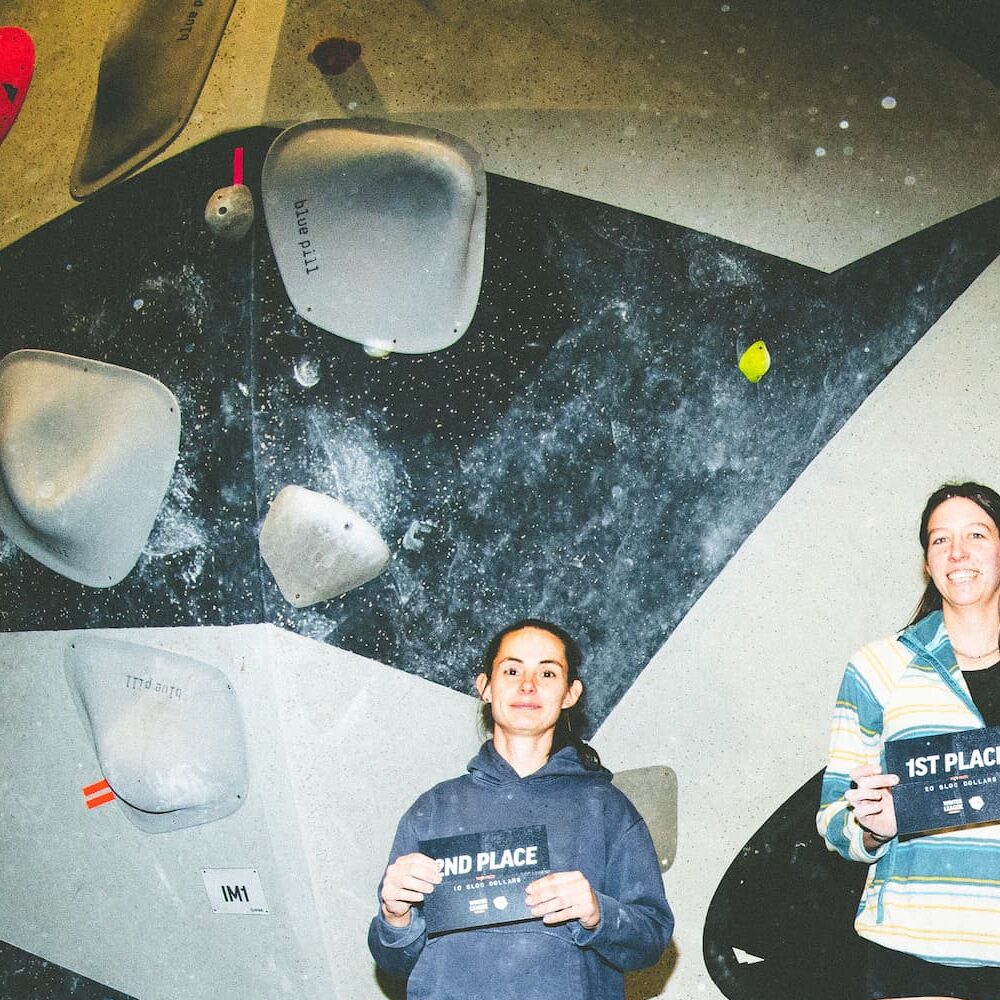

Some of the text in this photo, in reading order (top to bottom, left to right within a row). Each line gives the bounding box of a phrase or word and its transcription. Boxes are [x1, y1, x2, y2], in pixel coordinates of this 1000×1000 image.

[294, 199, 319, 275] blue pill
[905, 755, 940, 778] 1ST
[963, 776, 997, 787] DOLLARS
[476, 846, 538, 872] PLACE
[488, 877, 521, 886] DOLLARS
[221, 885, 249, 902] IM1
